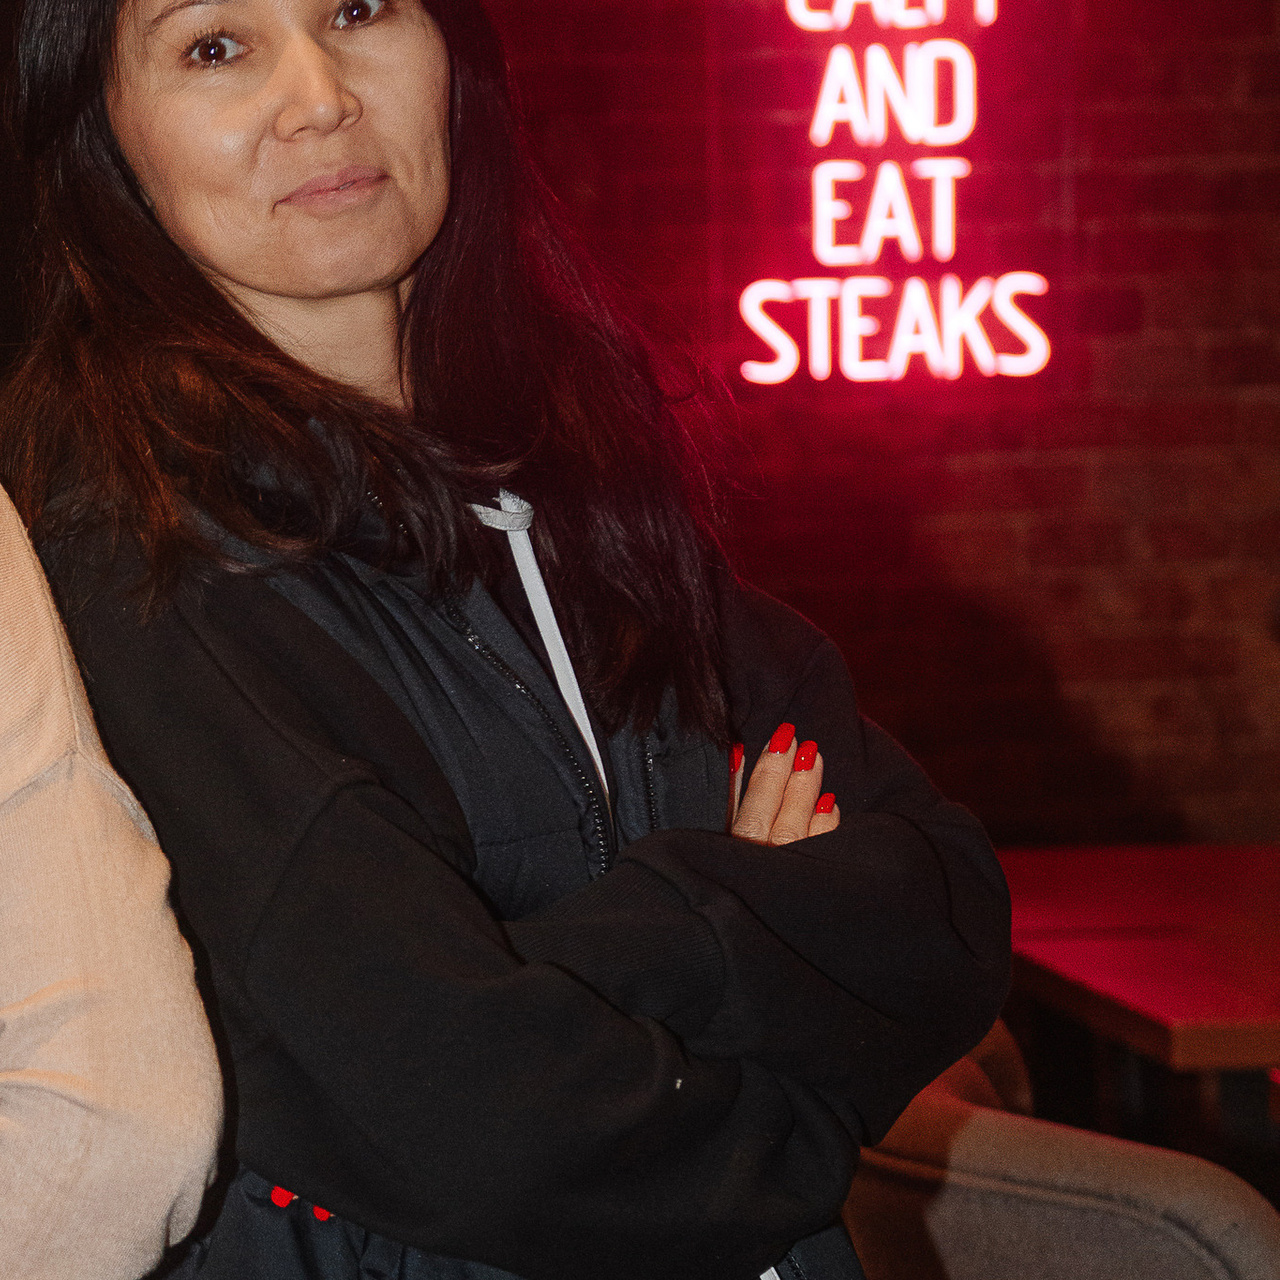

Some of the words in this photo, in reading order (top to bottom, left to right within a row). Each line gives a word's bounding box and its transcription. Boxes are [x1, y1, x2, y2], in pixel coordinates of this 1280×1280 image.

[809, 38, 976, 146] AND
[811, 156, 970, 266] EAT
[739, 270, 1050, 384] STEAKS
